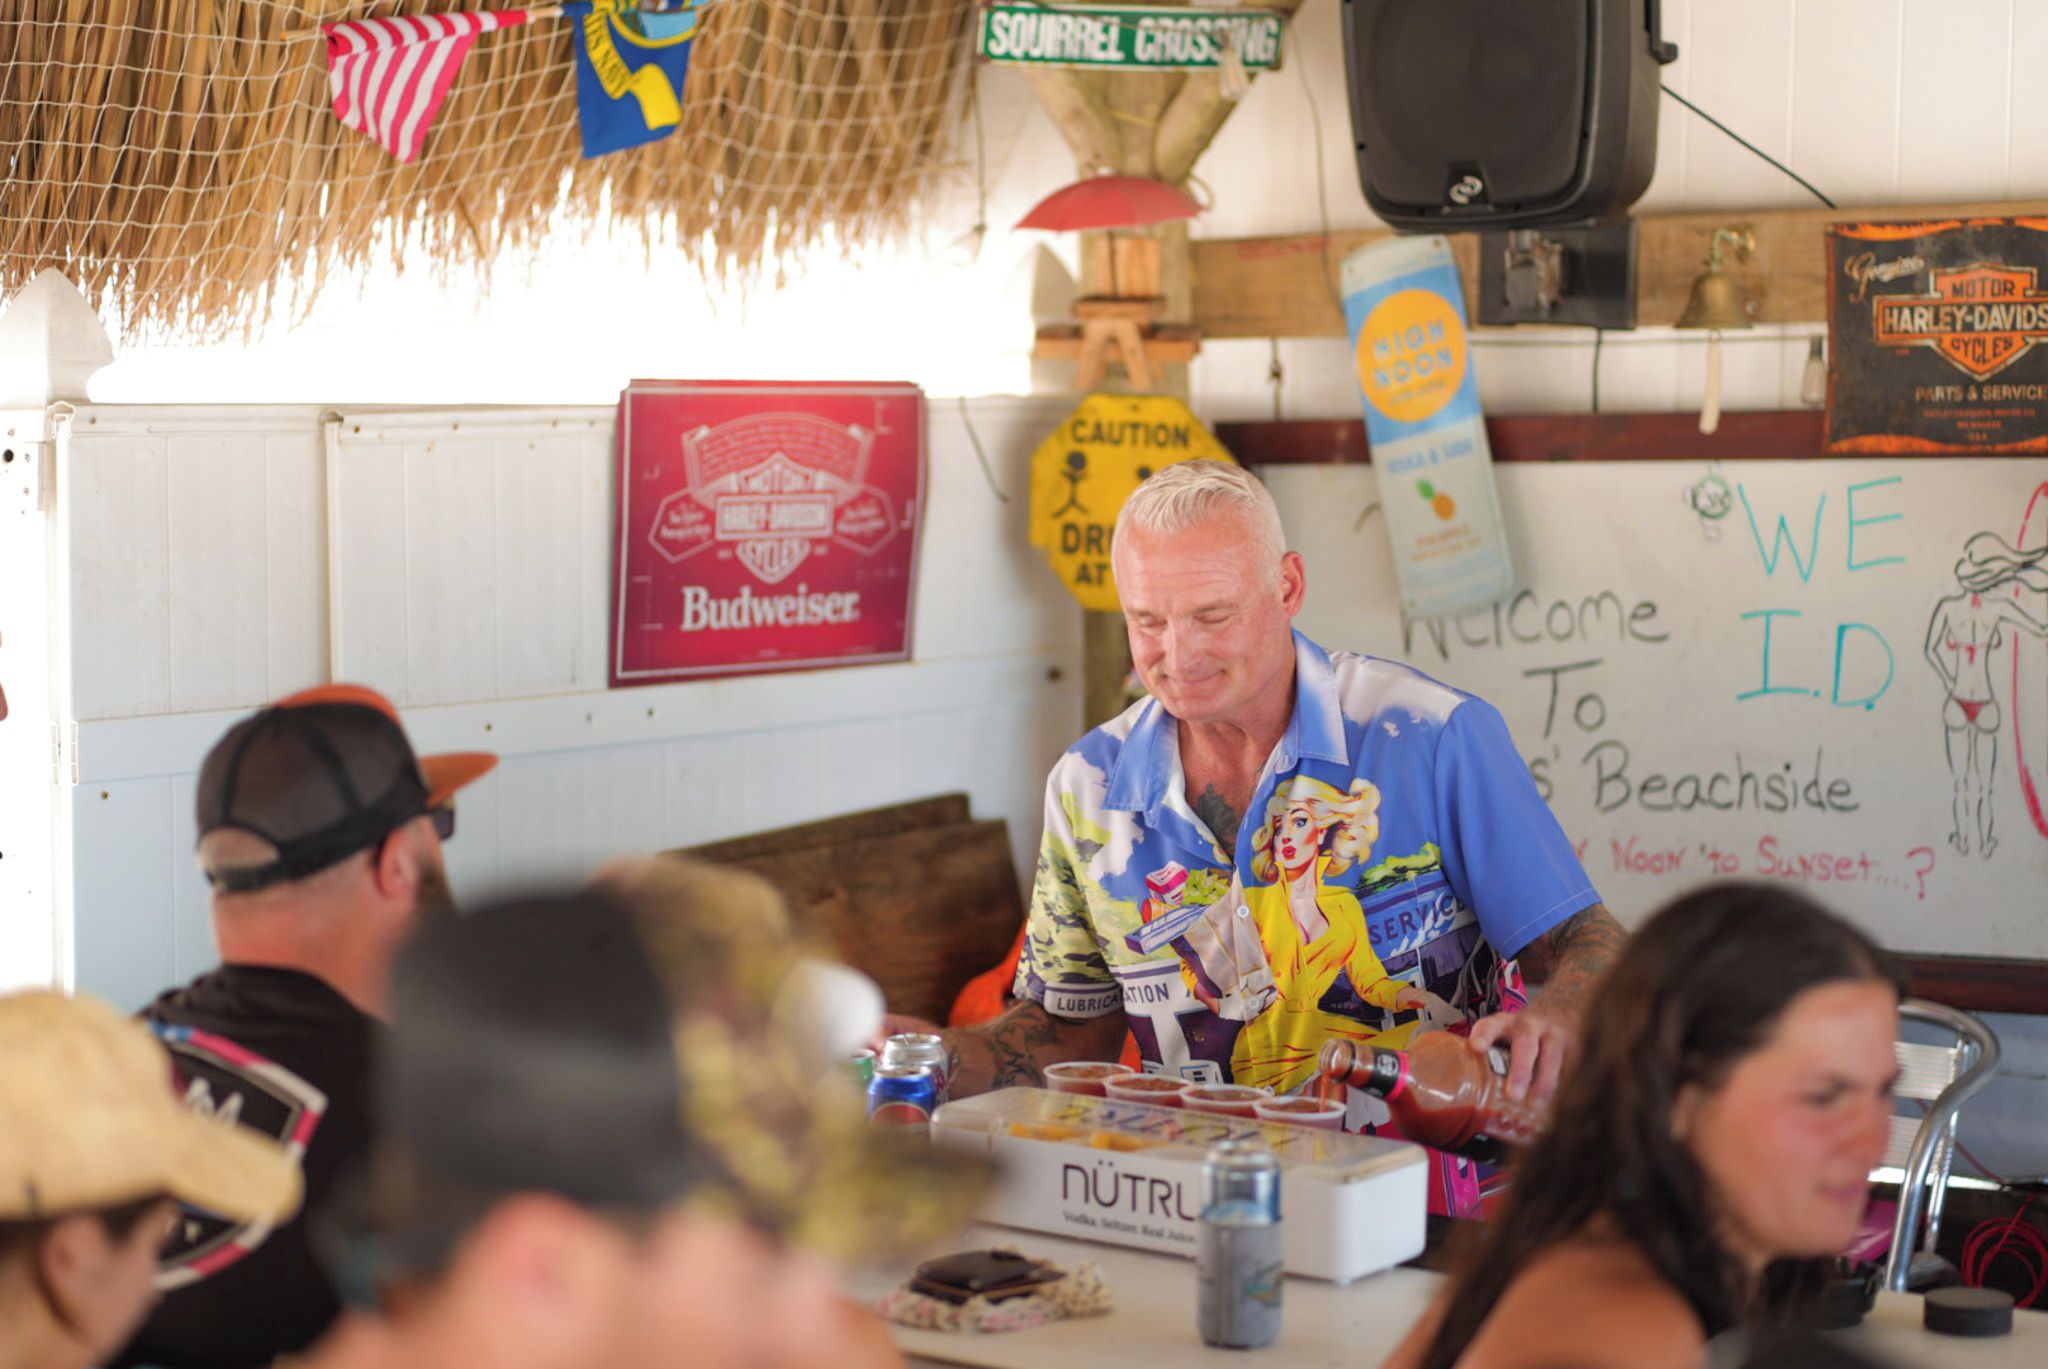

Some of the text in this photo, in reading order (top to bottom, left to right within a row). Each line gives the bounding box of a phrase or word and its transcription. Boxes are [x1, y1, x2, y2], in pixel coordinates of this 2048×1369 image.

[988, 11, 1125, 61] SQUIRREL
[1952, 277, 2016, 298] MOTOR
[1373, 319, 1446, 360] HIGH
[1951, 336, 2014, 365] CYCLES
[1374, 346, 1455, 390] NOON
[1915, 386, 1964, 402] PARTS
[1071, 419, 1190, 448] CAUTION
[680, 582, 861, 632] Budweiser
[1522, 657, 1606, 739] To
[1582, 740, 1860, 814] Beachside
[1062, 1159, 1196, 1222] NÜTRL
